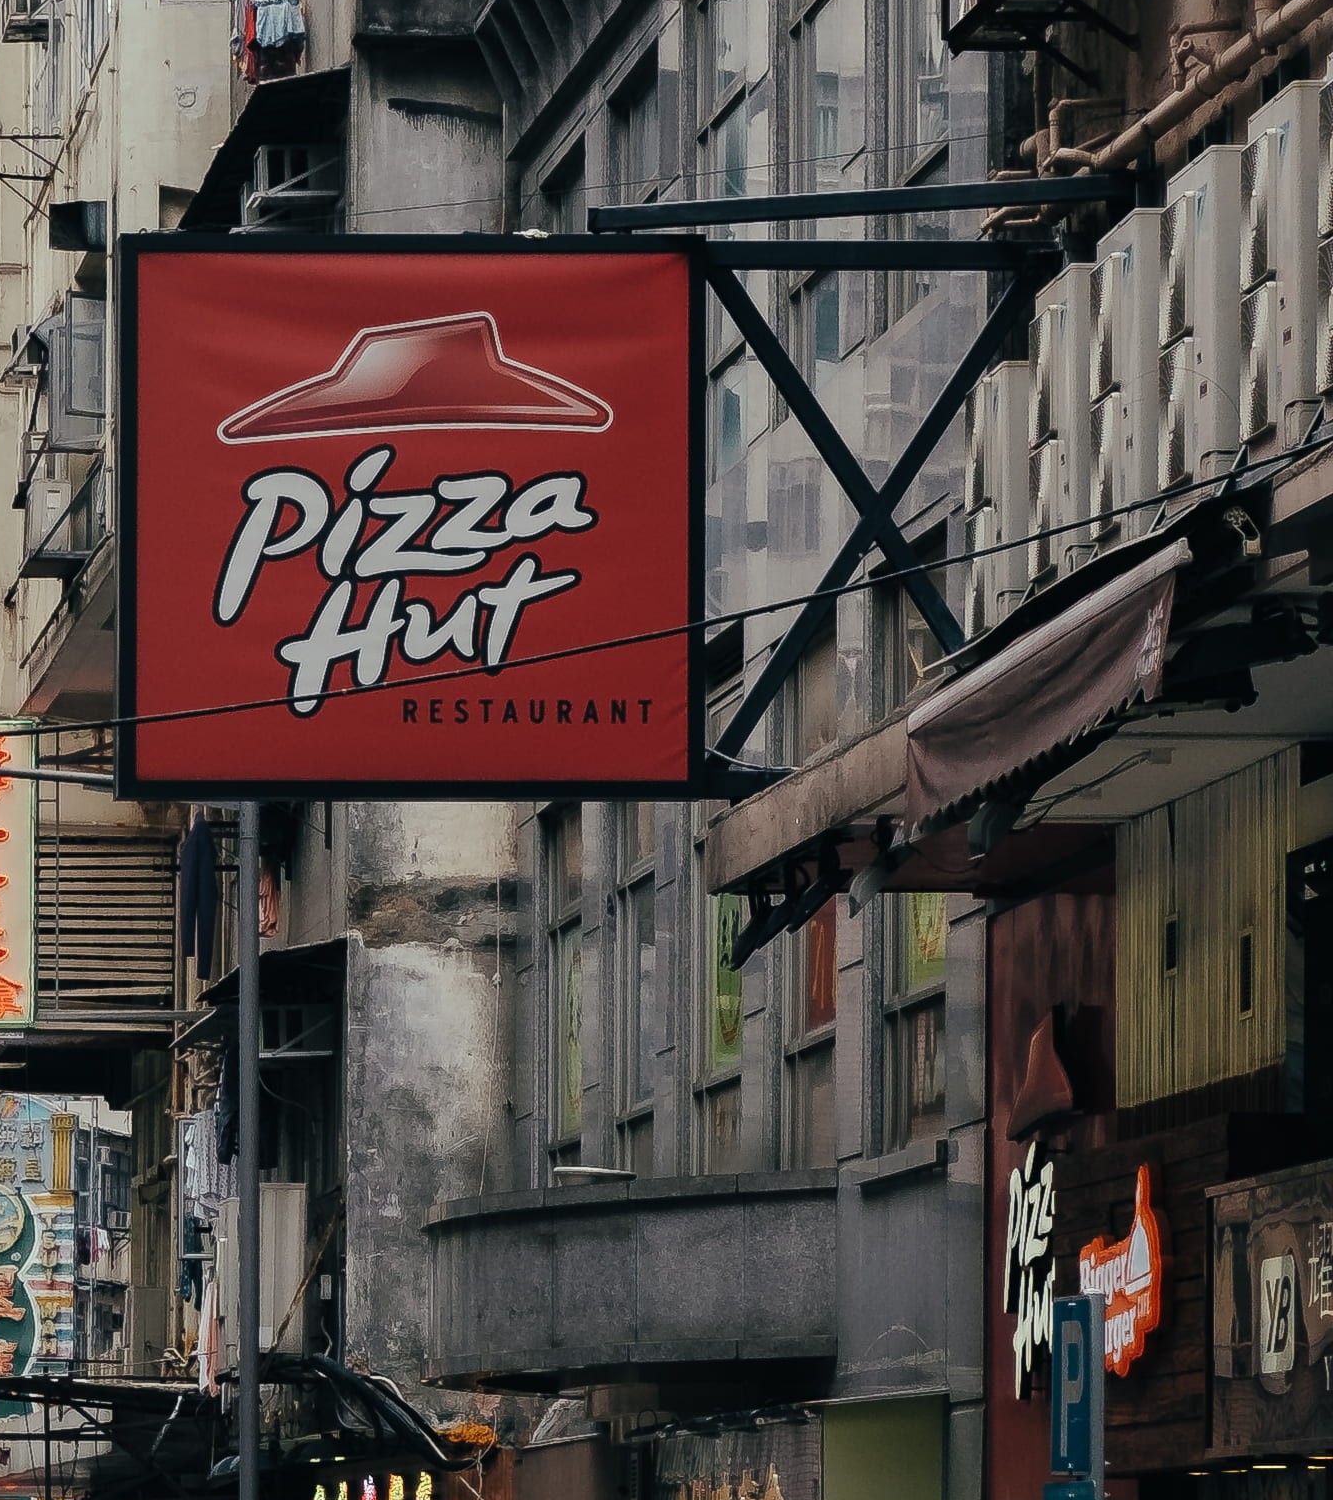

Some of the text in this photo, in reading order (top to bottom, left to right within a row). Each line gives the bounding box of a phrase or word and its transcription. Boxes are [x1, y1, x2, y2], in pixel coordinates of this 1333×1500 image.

[214, 445, 598, 621] Pizza
[276, 554, 581, 717] Hut
[403, 700, 653, 723] RESTAURANT
[1004, 1141, 1055, 1313] Pizz
[1013, 1256, 1055, 1400] Hu
[1061, 1320, 1084, 1458] P
